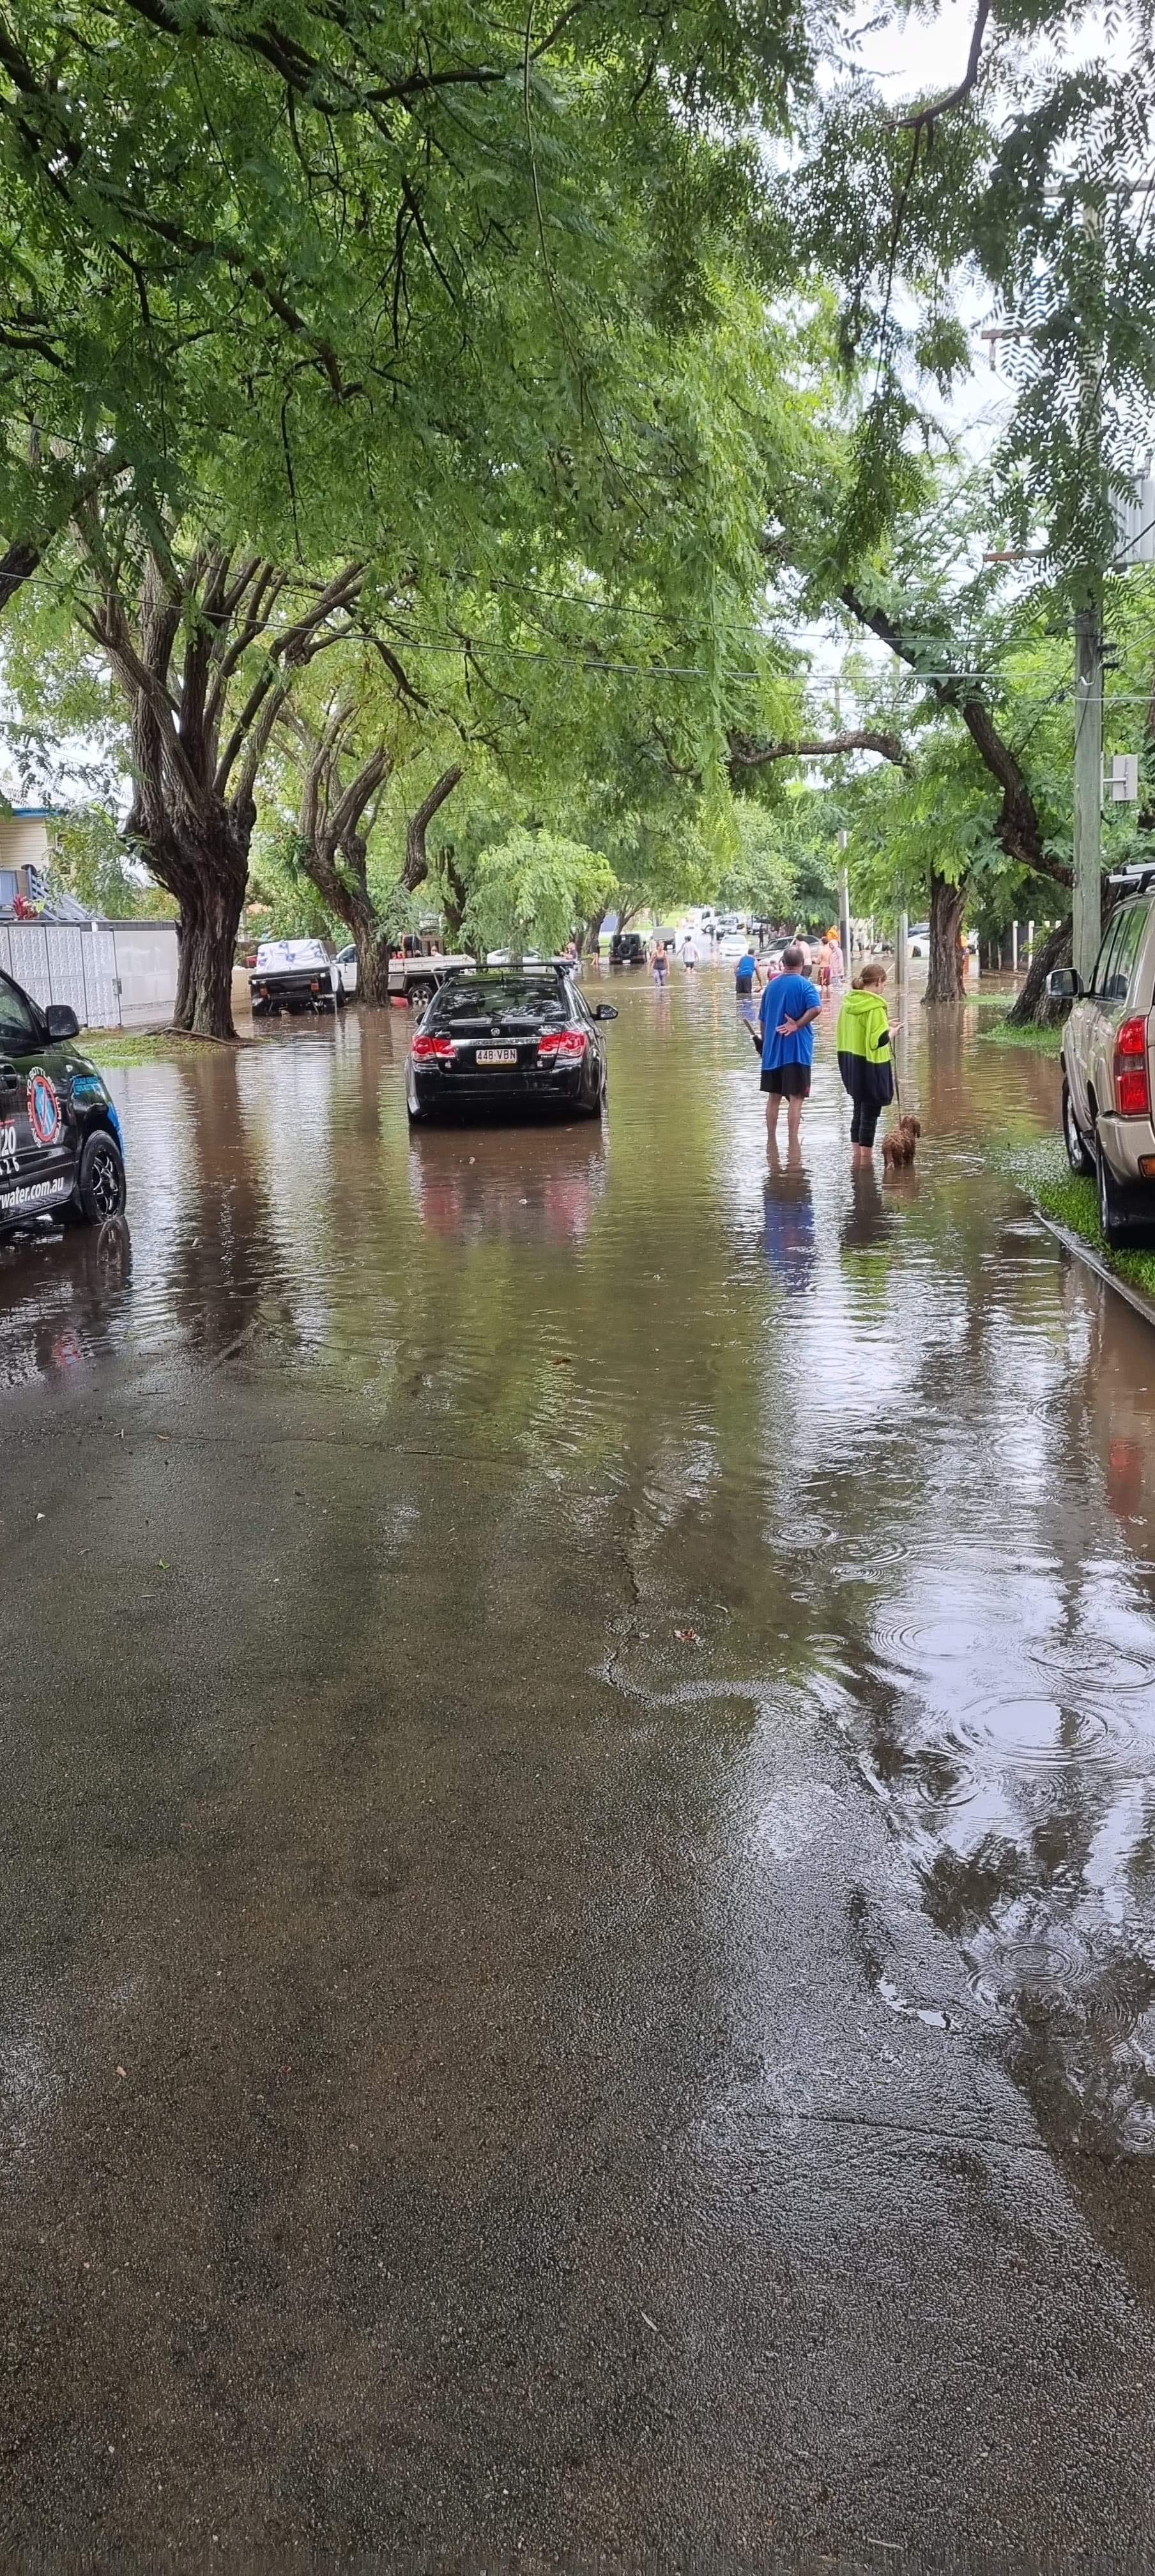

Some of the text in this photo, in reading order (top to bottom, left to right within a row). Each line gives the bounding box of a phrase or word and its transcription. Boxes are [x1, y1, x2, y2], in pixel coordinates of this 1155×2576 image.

[27, 1079, 32, 1096] TO
[29, 1066, 56, 1093] BOTTLED
[27, 1101, 33, 1123] NO
[52, 1096, 62, 1144] WATER
[0, 1177, 64, 1209] water.com.au
